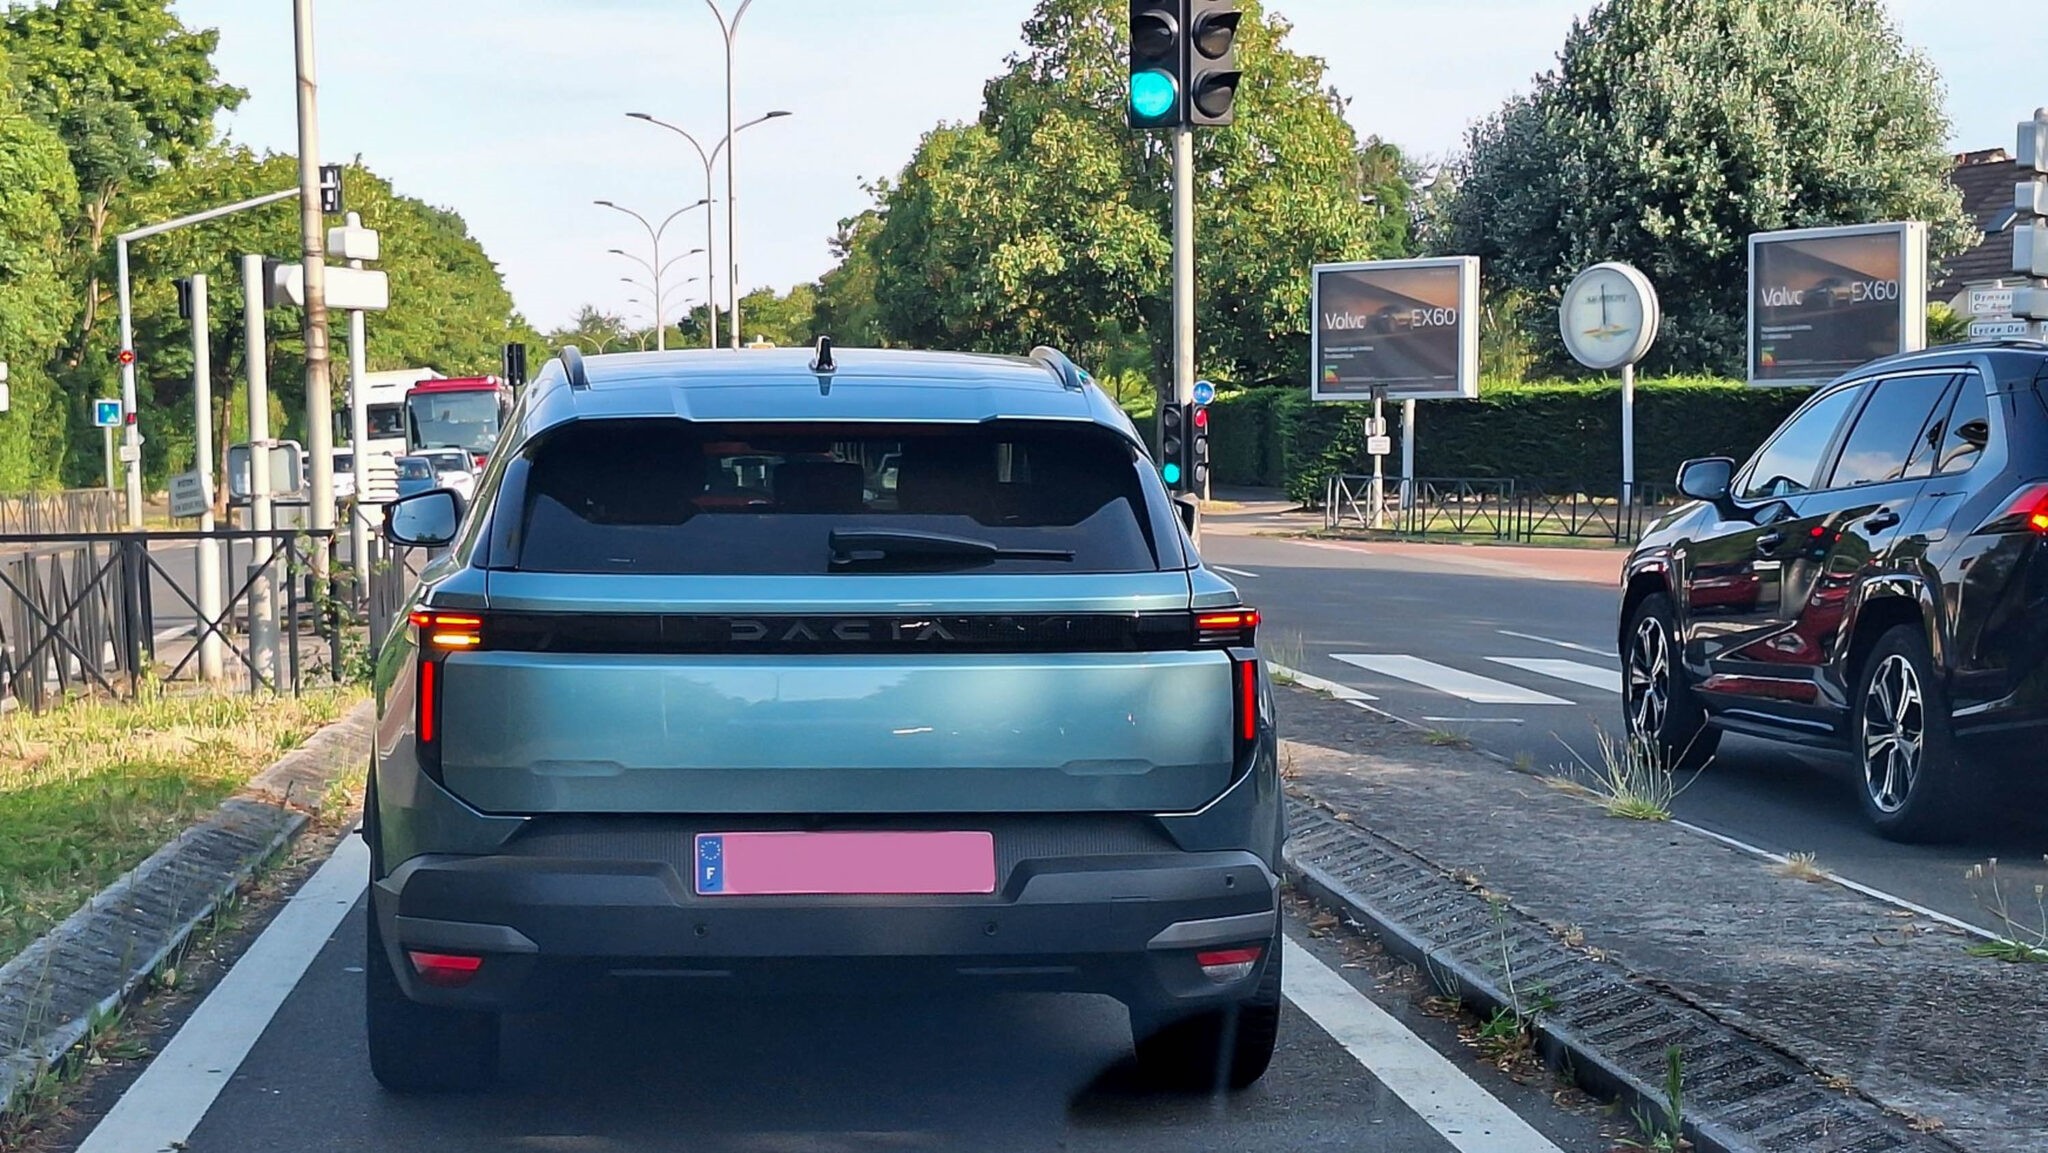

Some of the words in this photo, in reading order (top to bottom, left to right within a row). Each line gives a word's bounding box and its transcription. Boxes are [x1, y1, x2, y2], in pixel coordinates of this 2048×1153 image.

[1851, 280, 1898, 302] EX60
[1411, 308, 1456, 327] EX60
[730, 620, 955, 640] DACIA
[706, 867, 716, 880] F
